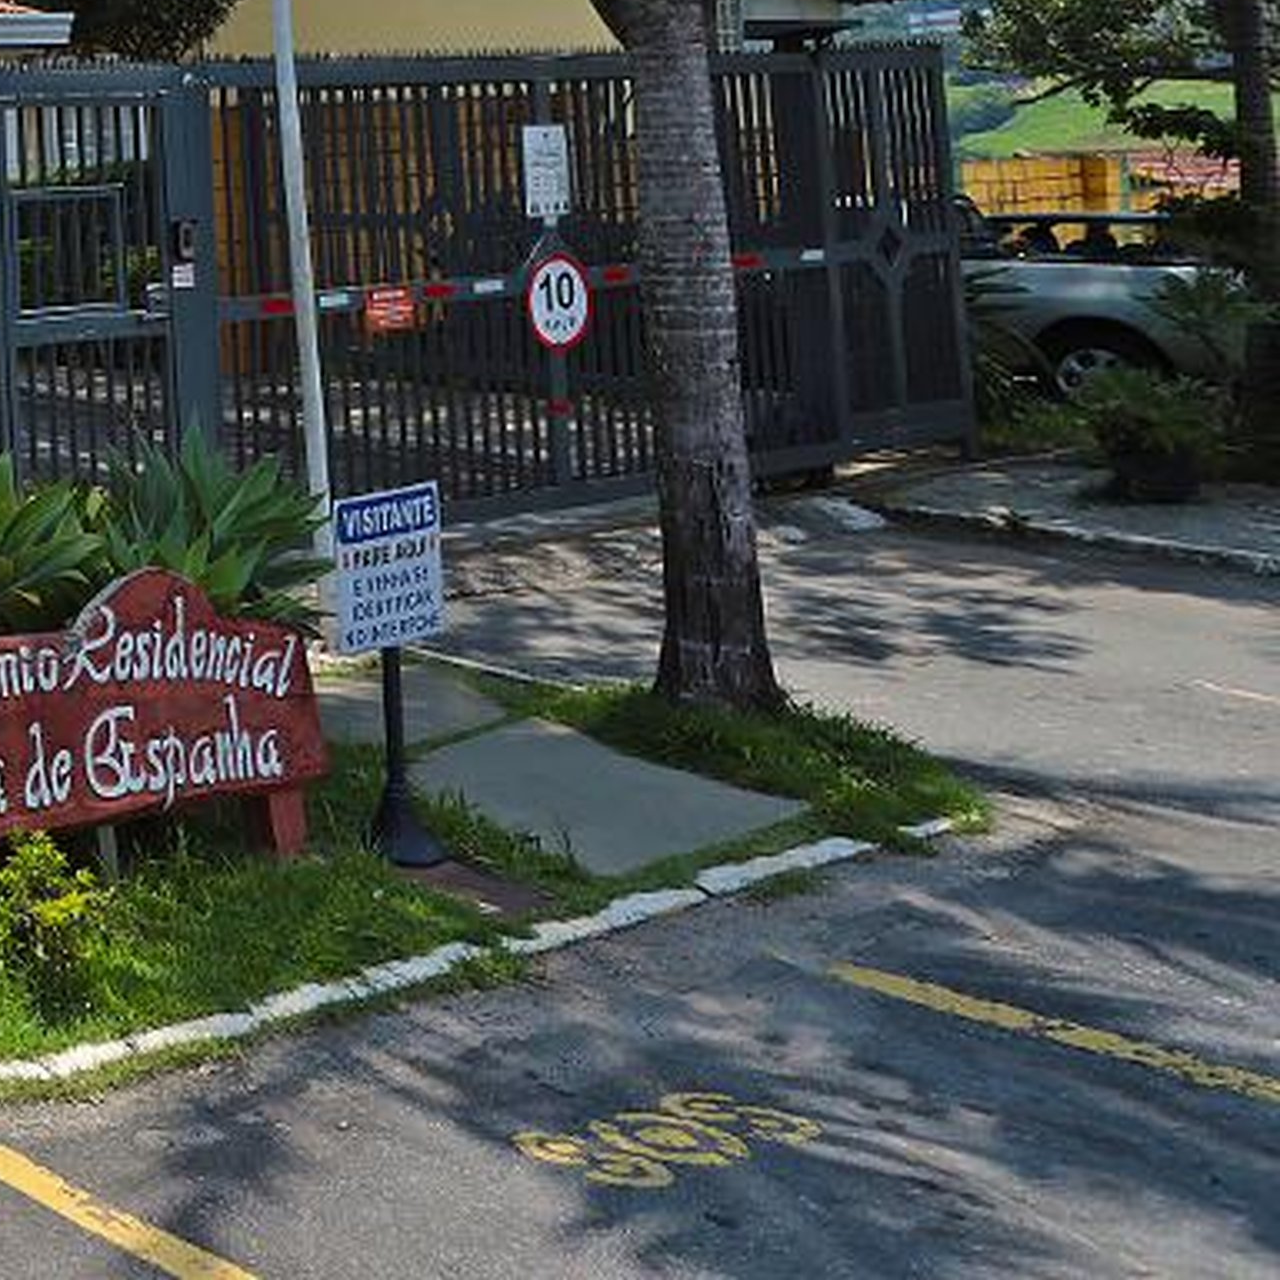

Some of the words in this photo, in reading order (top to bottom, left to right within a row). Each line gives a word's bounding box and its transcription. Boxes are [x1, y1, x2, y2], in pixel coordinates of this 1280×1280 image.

[539, 273, 574, 311] 10
[342, 496, 434, 537] VISITANTE
[65, 598, 296, 698] Residencial
[26, 723, 72, 808] de
[86, 696, 282, 810] Espanha
